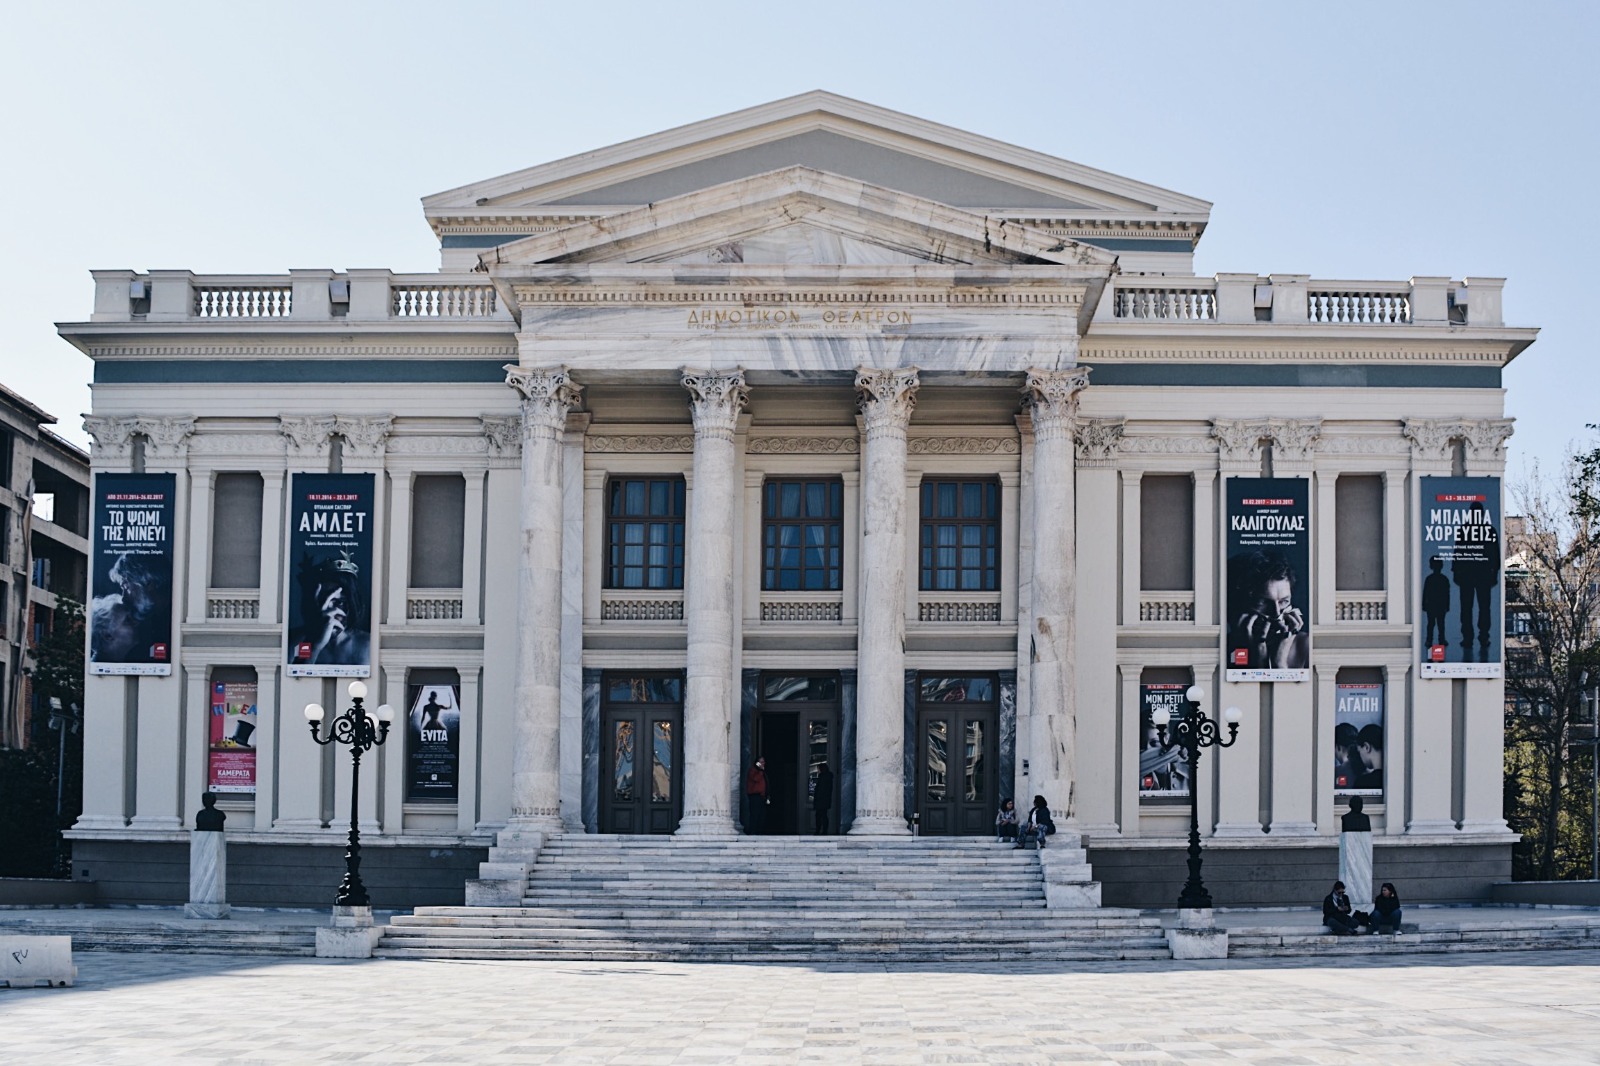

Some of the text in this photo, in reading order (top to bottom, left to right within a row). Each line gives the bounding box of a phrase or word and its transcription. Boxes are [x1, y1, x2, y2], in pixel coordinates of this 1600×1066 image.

[688, 310, 912, 323] ΔΗΜΟΤΙΚΟΝ ΘΕΑΤΡΟΝ
[109, 510, 160, 526] ΤΟ ΨΩΜΙ
[299, 511, 366, 532] ΑΜΛΕΤ
[1231, 515, 1305, 531] ΚΑΛΙΓΟΥΛΑΣ
[1430, 508, 1492, 525] ΜΠΑΜΠΑ
[102, 525, 166, 541] ΤΗΣ ΝΙΝΕΥΙ
[1425, 525, 1497, 543] ΧΟΡΕΥΕΙΣ;
[1145, 694, 1184, 704] MON PETIT
[1338, 697, 1379, 713] ΑΓΑΠΗ
[420, 729, 448, 742] EVITA
[217, 769, 250, 777] ΚΑΜΕΡΑΤΑ
